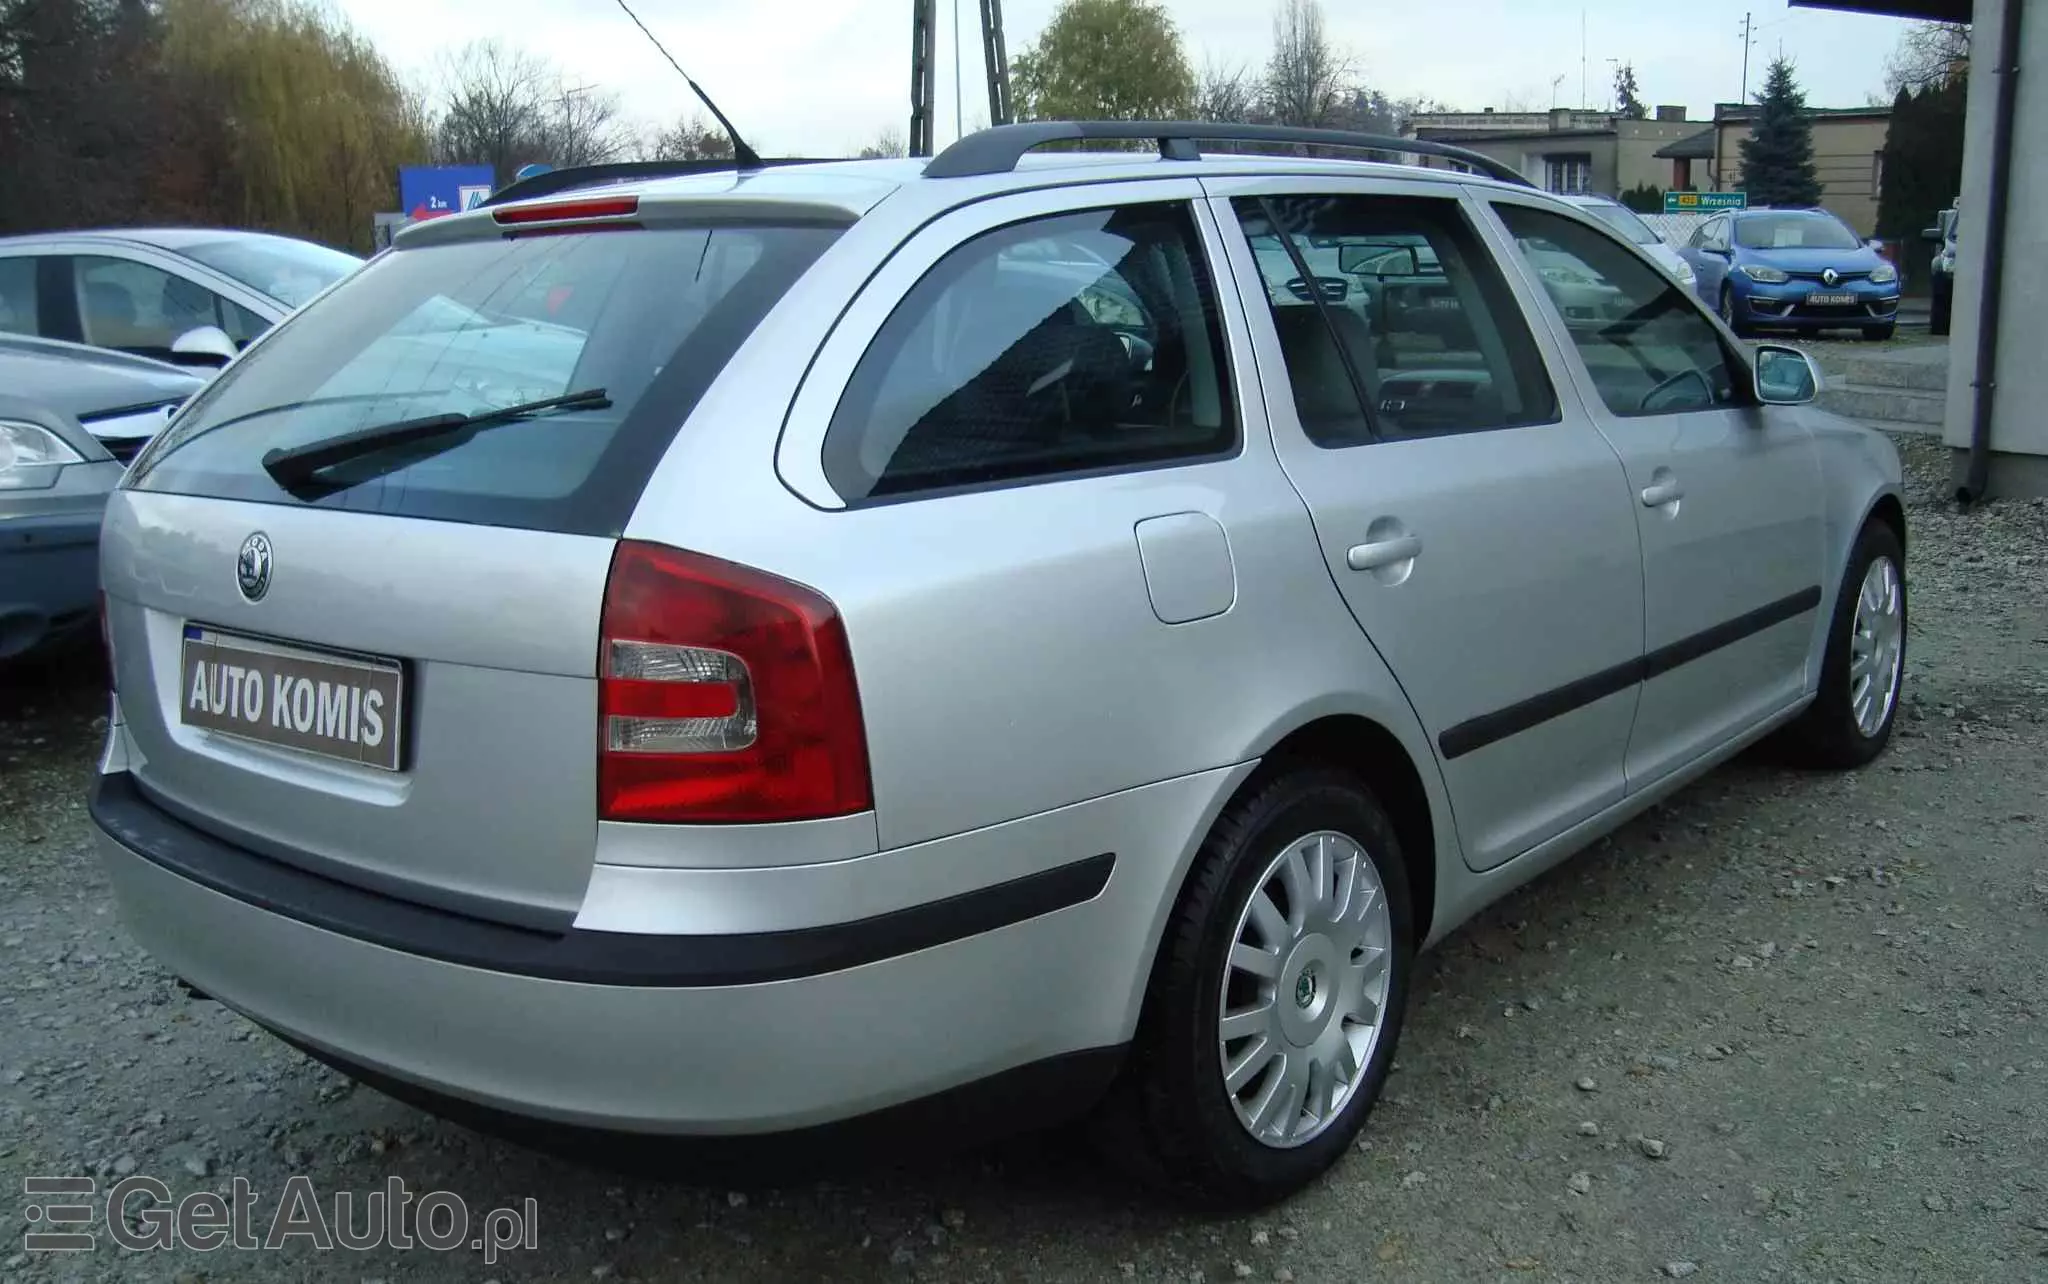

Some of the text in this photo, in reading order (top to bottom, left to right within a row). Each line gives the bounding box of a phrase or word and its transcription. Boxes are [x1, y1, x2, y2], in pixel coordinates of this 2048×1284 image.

[430, 196, 447, 209] 2 km
[1809, 295, 1829, 304] AUTO
[190, 660, 385, 747] AUTO KOMIS
